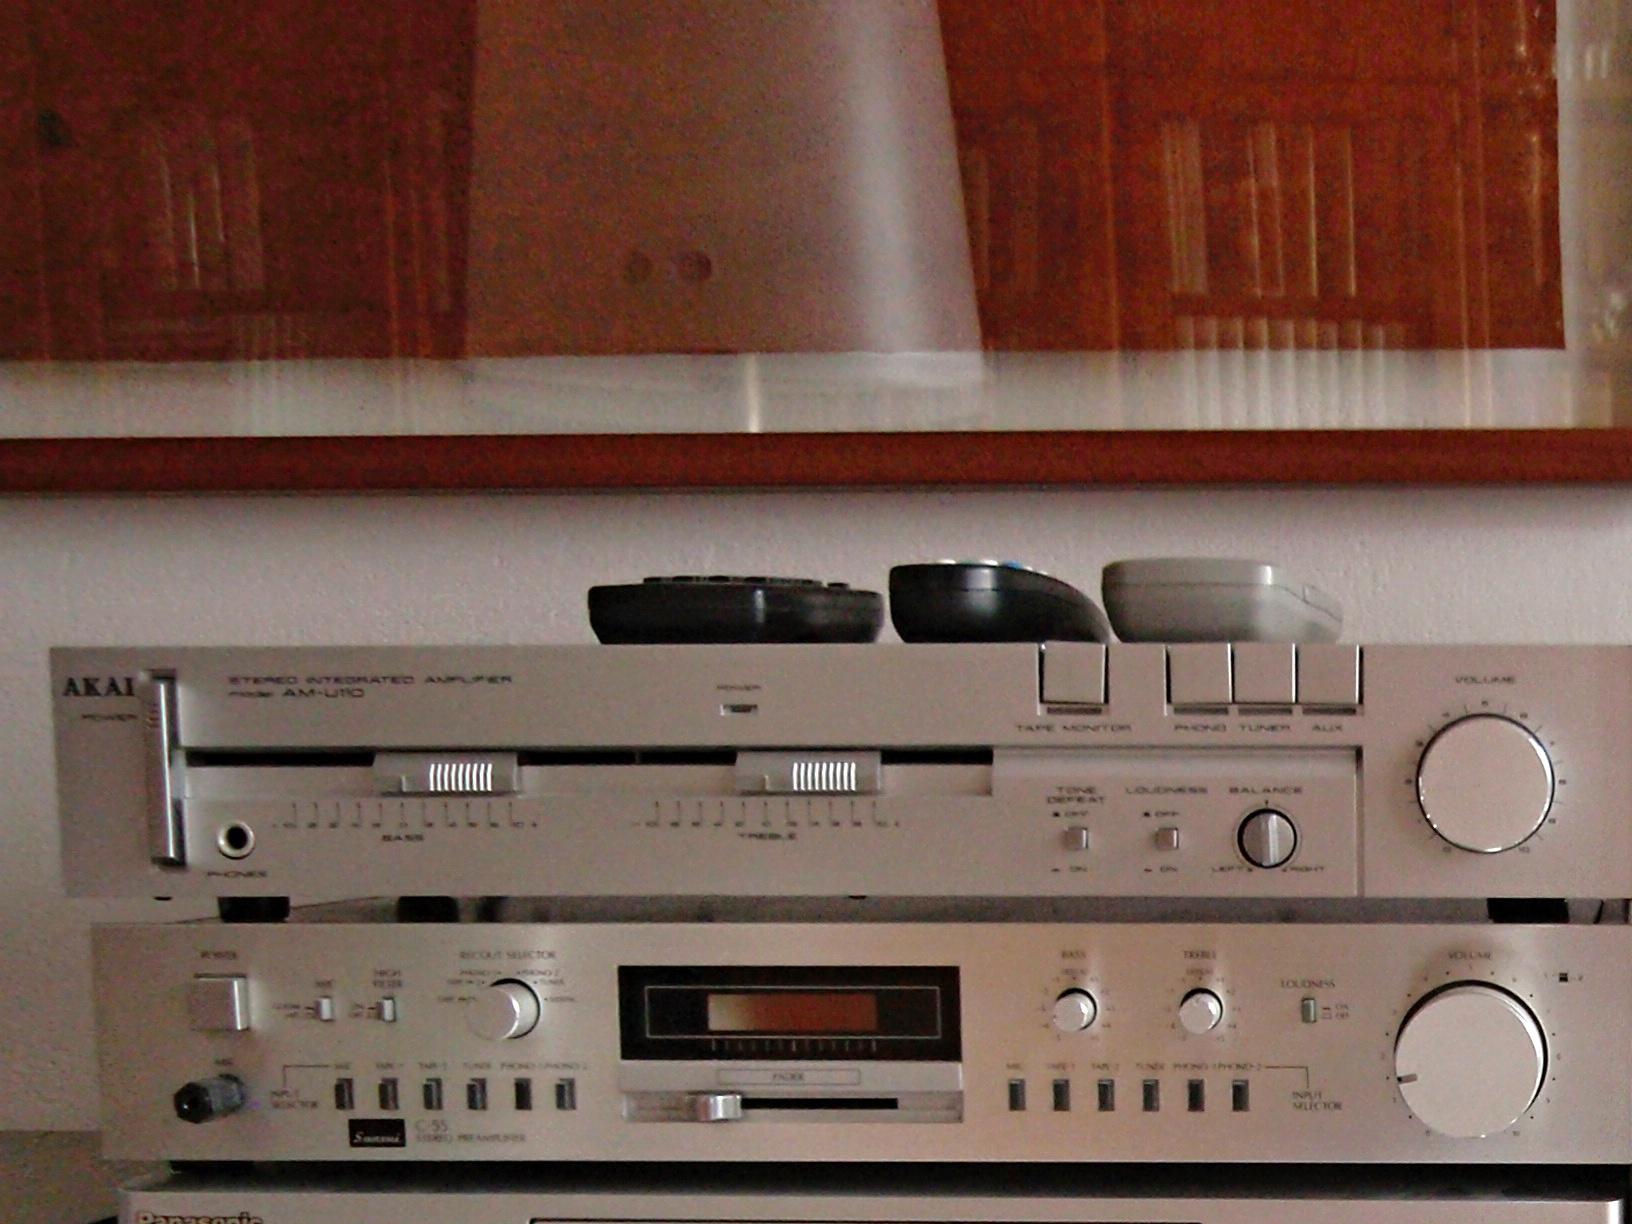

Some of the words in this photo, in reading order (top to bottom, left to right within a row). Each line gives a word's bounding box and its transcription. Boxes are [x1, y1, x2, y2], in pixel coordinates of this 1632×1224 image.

[228, 676, 296, 684] STEREO
[1455, 675, 1516, 685] VOLUME
[63, 677, 136, 697] AKAI
[1015, 724, 1056, 732] TAPE
[1063, 724, 1132, 732] MONITOR
[1174, 724, 1228, 733] PHONO
[1238, 724, 1290, 732] TUNER
[1311, 724, 1344, 732] AUX
[1055, 786, 1098, 794] TONE
[1125, 786, 1207, 794] LOUDNESS
[1229, 786, 1303, 794] BALANCE
[1281, 980, 1336, 988] LOUDNESS
[1293, 1102, 1342, 1110] SELECTOR
